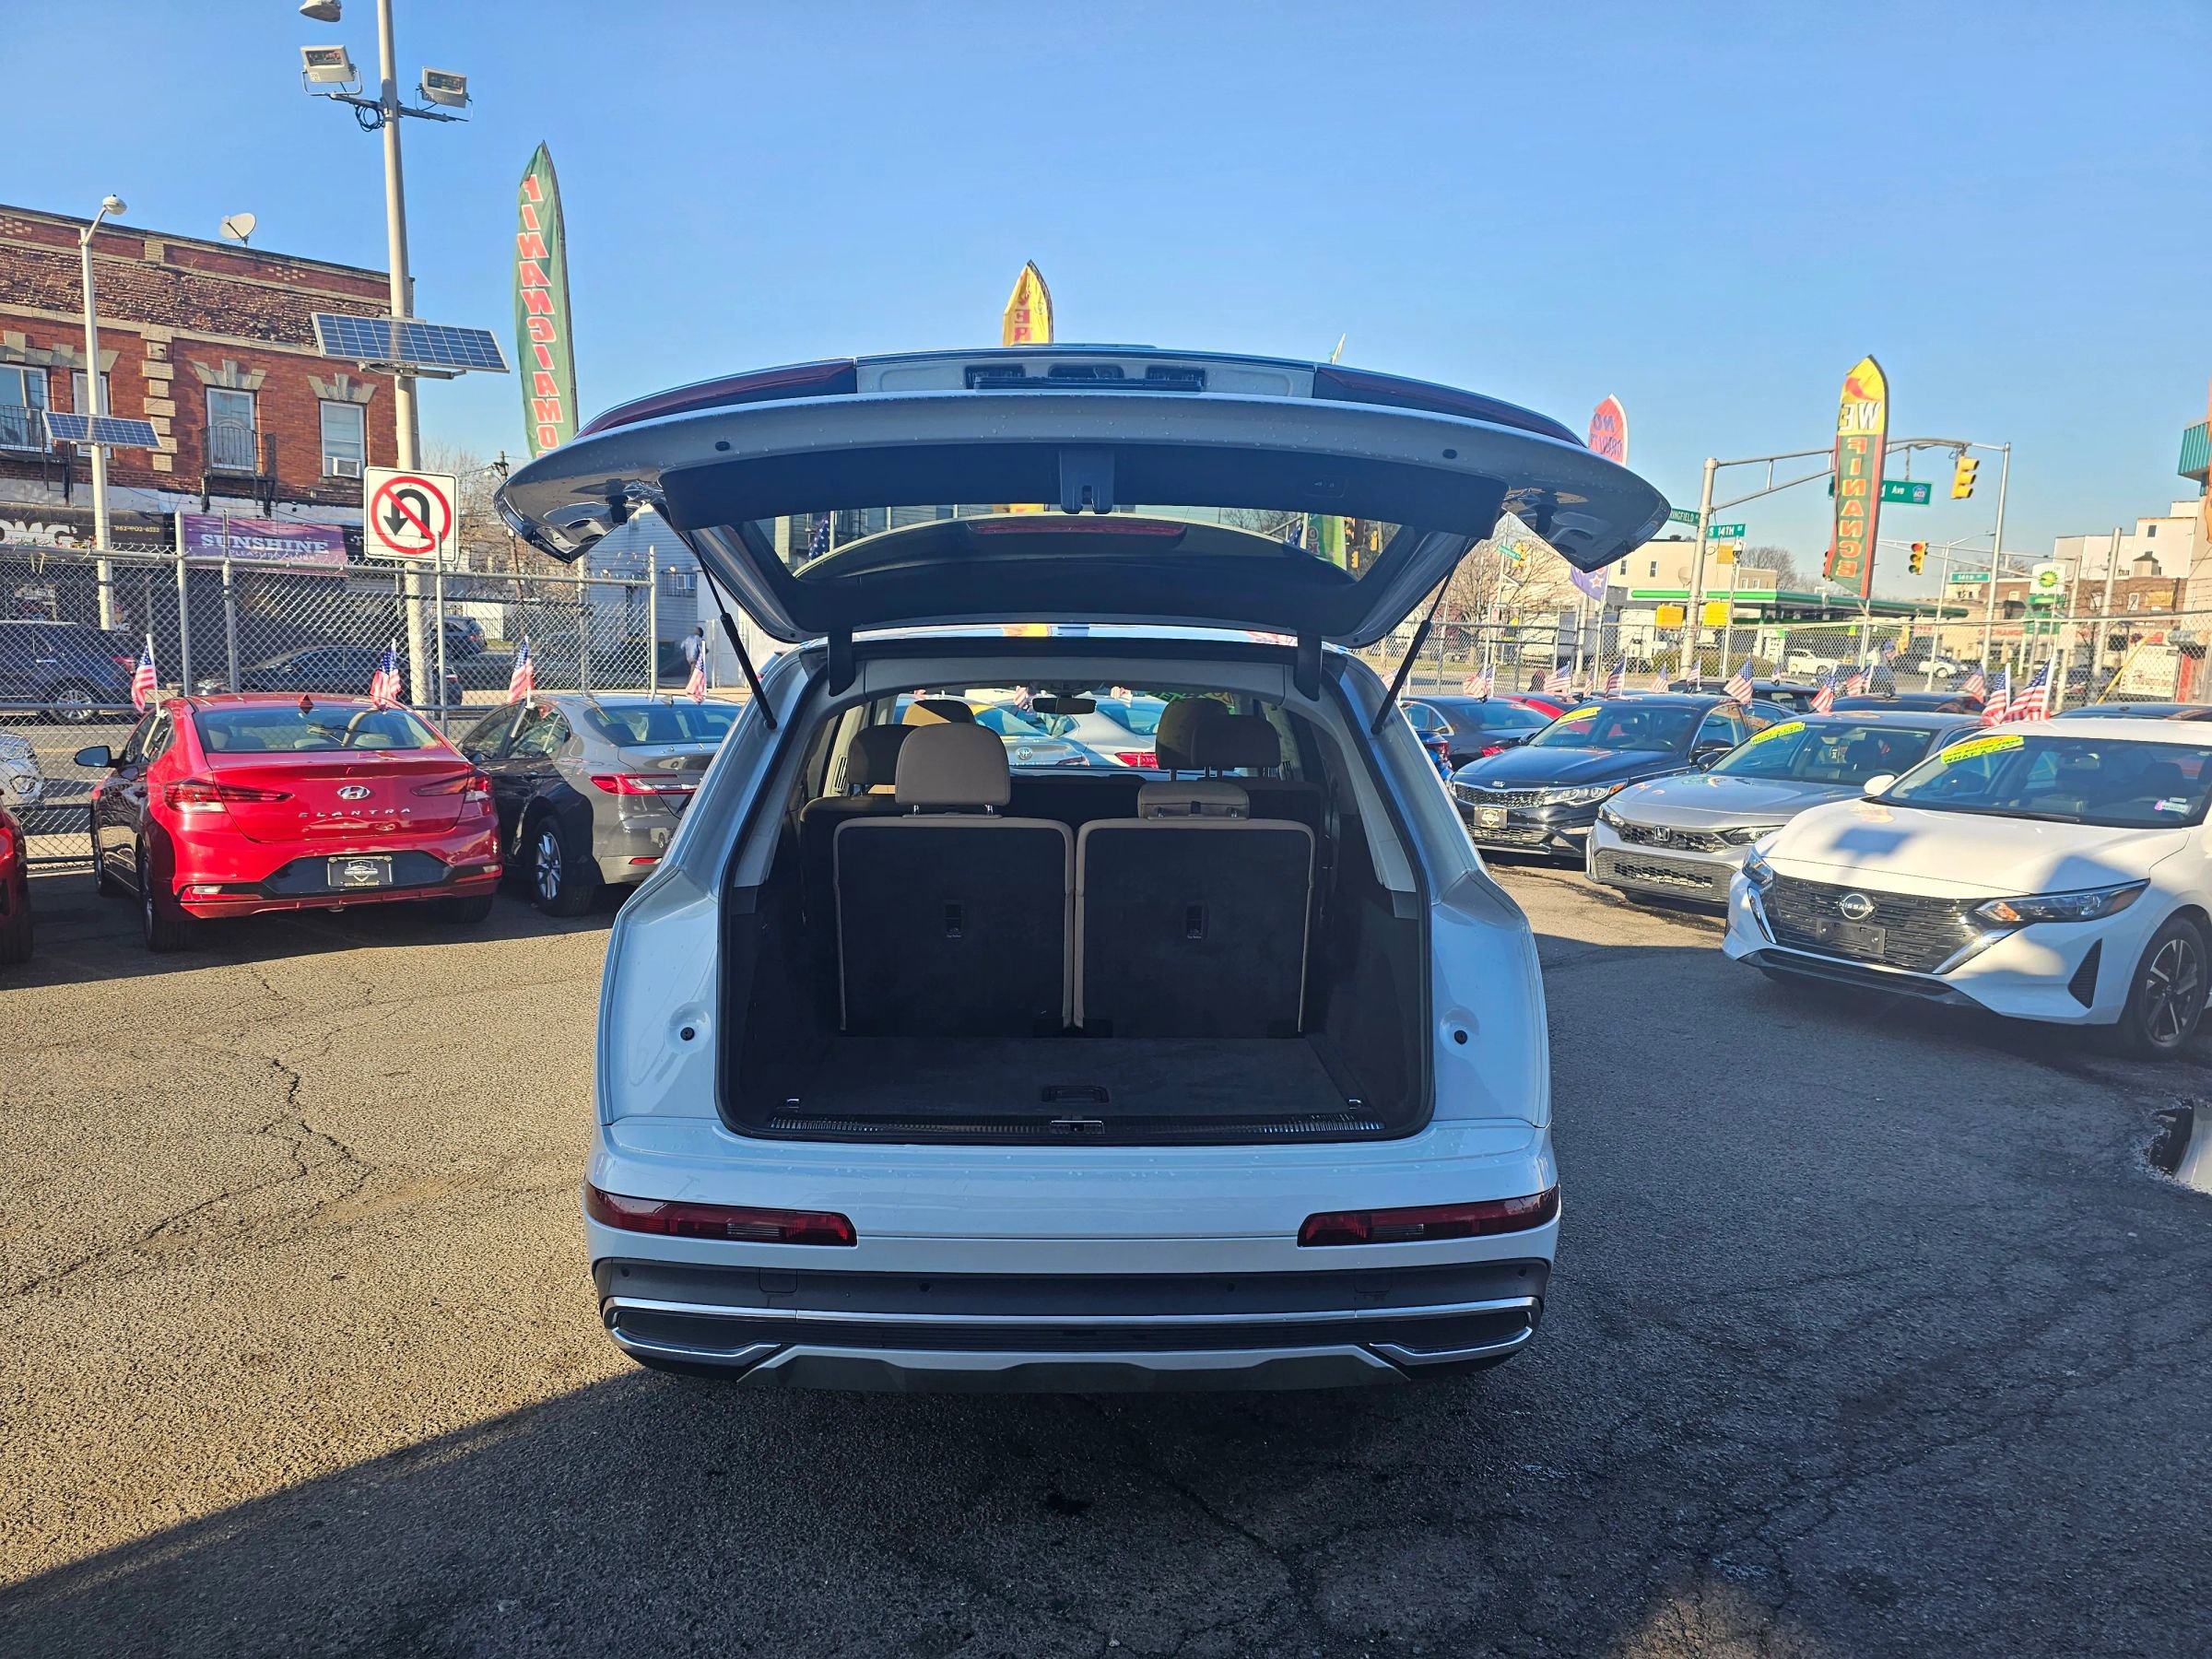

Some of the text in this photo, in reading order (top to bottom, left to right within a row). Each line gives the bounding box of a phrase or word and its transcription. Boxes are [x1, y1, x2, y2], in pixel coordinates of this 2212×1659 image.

[1891, 485, 1905, 495] Ave
[1709, 526, 1714, 536] S
[1718, 525, 1735, 536] 14TH
[200, 533, 330, 554] SUNSHINE
[1944, 752, 1976, 763] WHAT
[298, 807, 411, 818] ELANTRA
[1839, 901, 1875, 912] NISSAN
